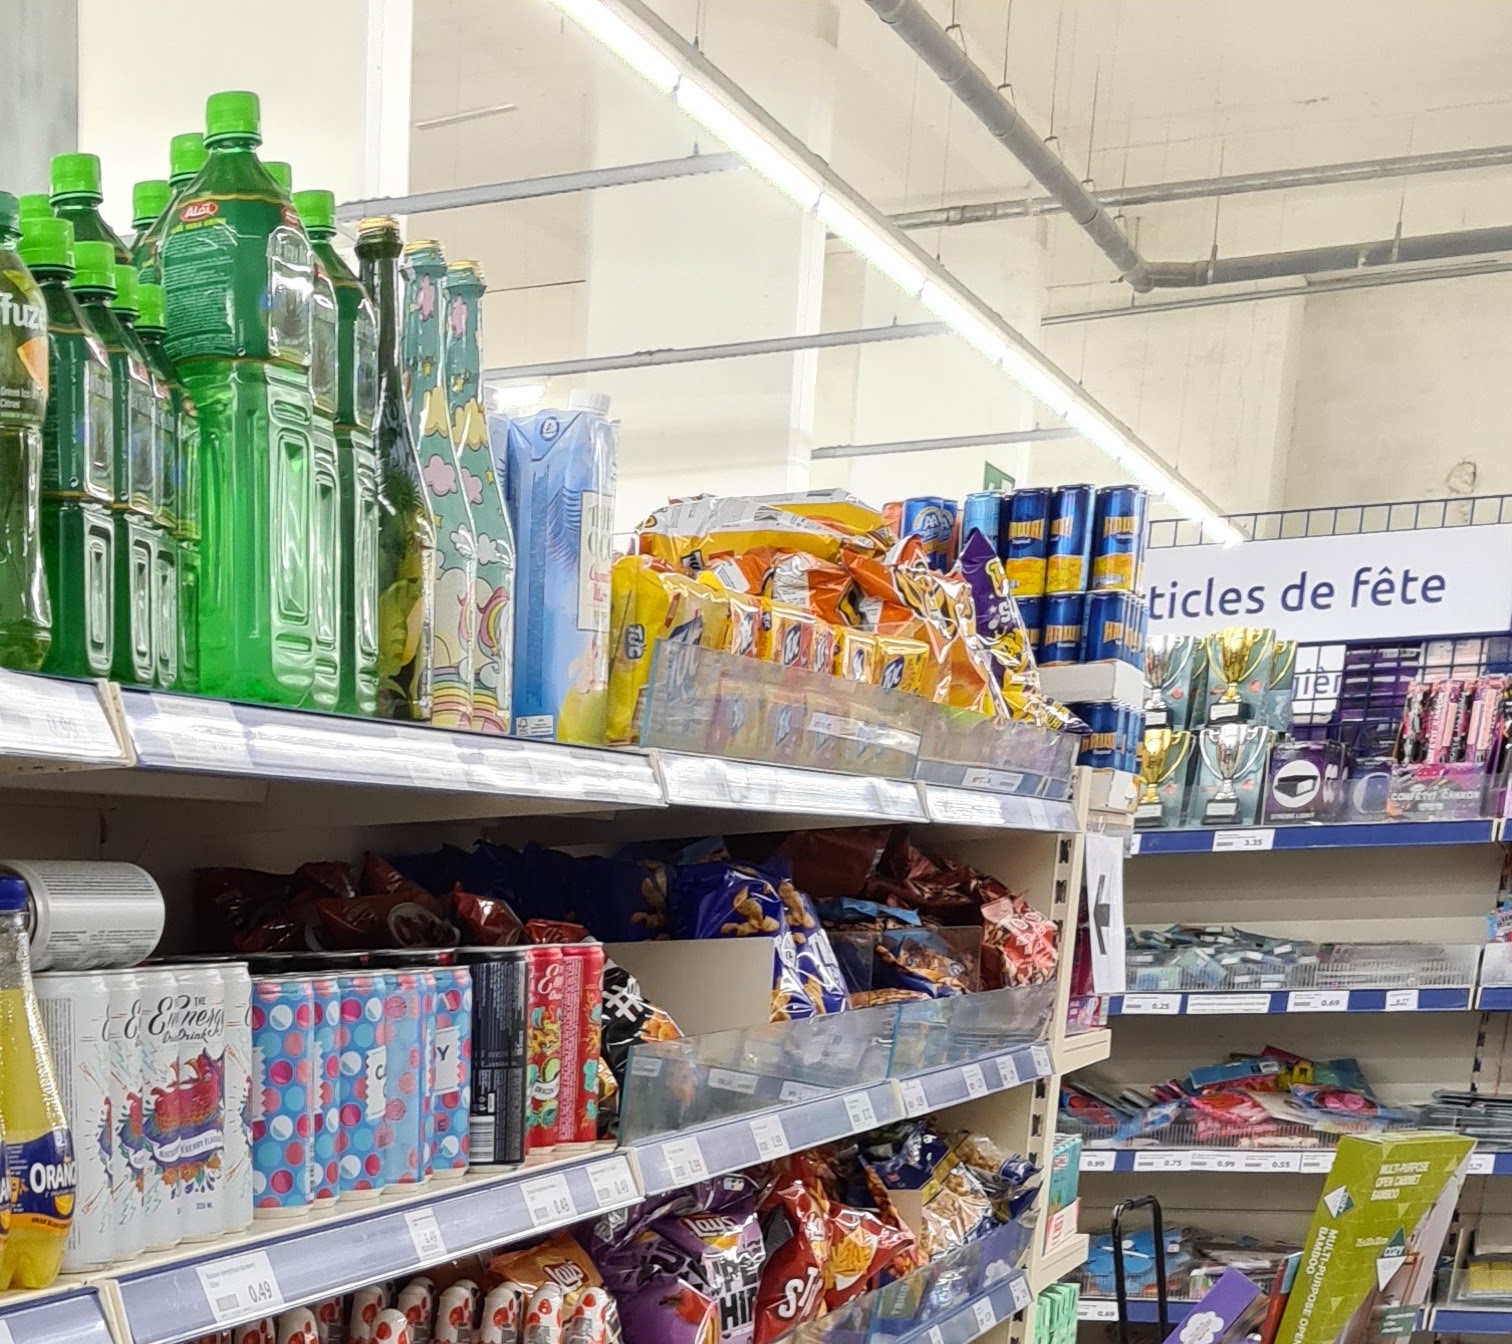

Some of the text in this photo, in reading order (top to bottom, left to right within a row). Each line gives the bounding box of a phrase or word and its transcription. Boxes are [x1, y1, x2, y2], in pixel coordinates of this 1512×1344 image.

[1139, 566, 1446, 621] ticles de fête
[1306, 1226, 1329, 1276] BAMBOO
